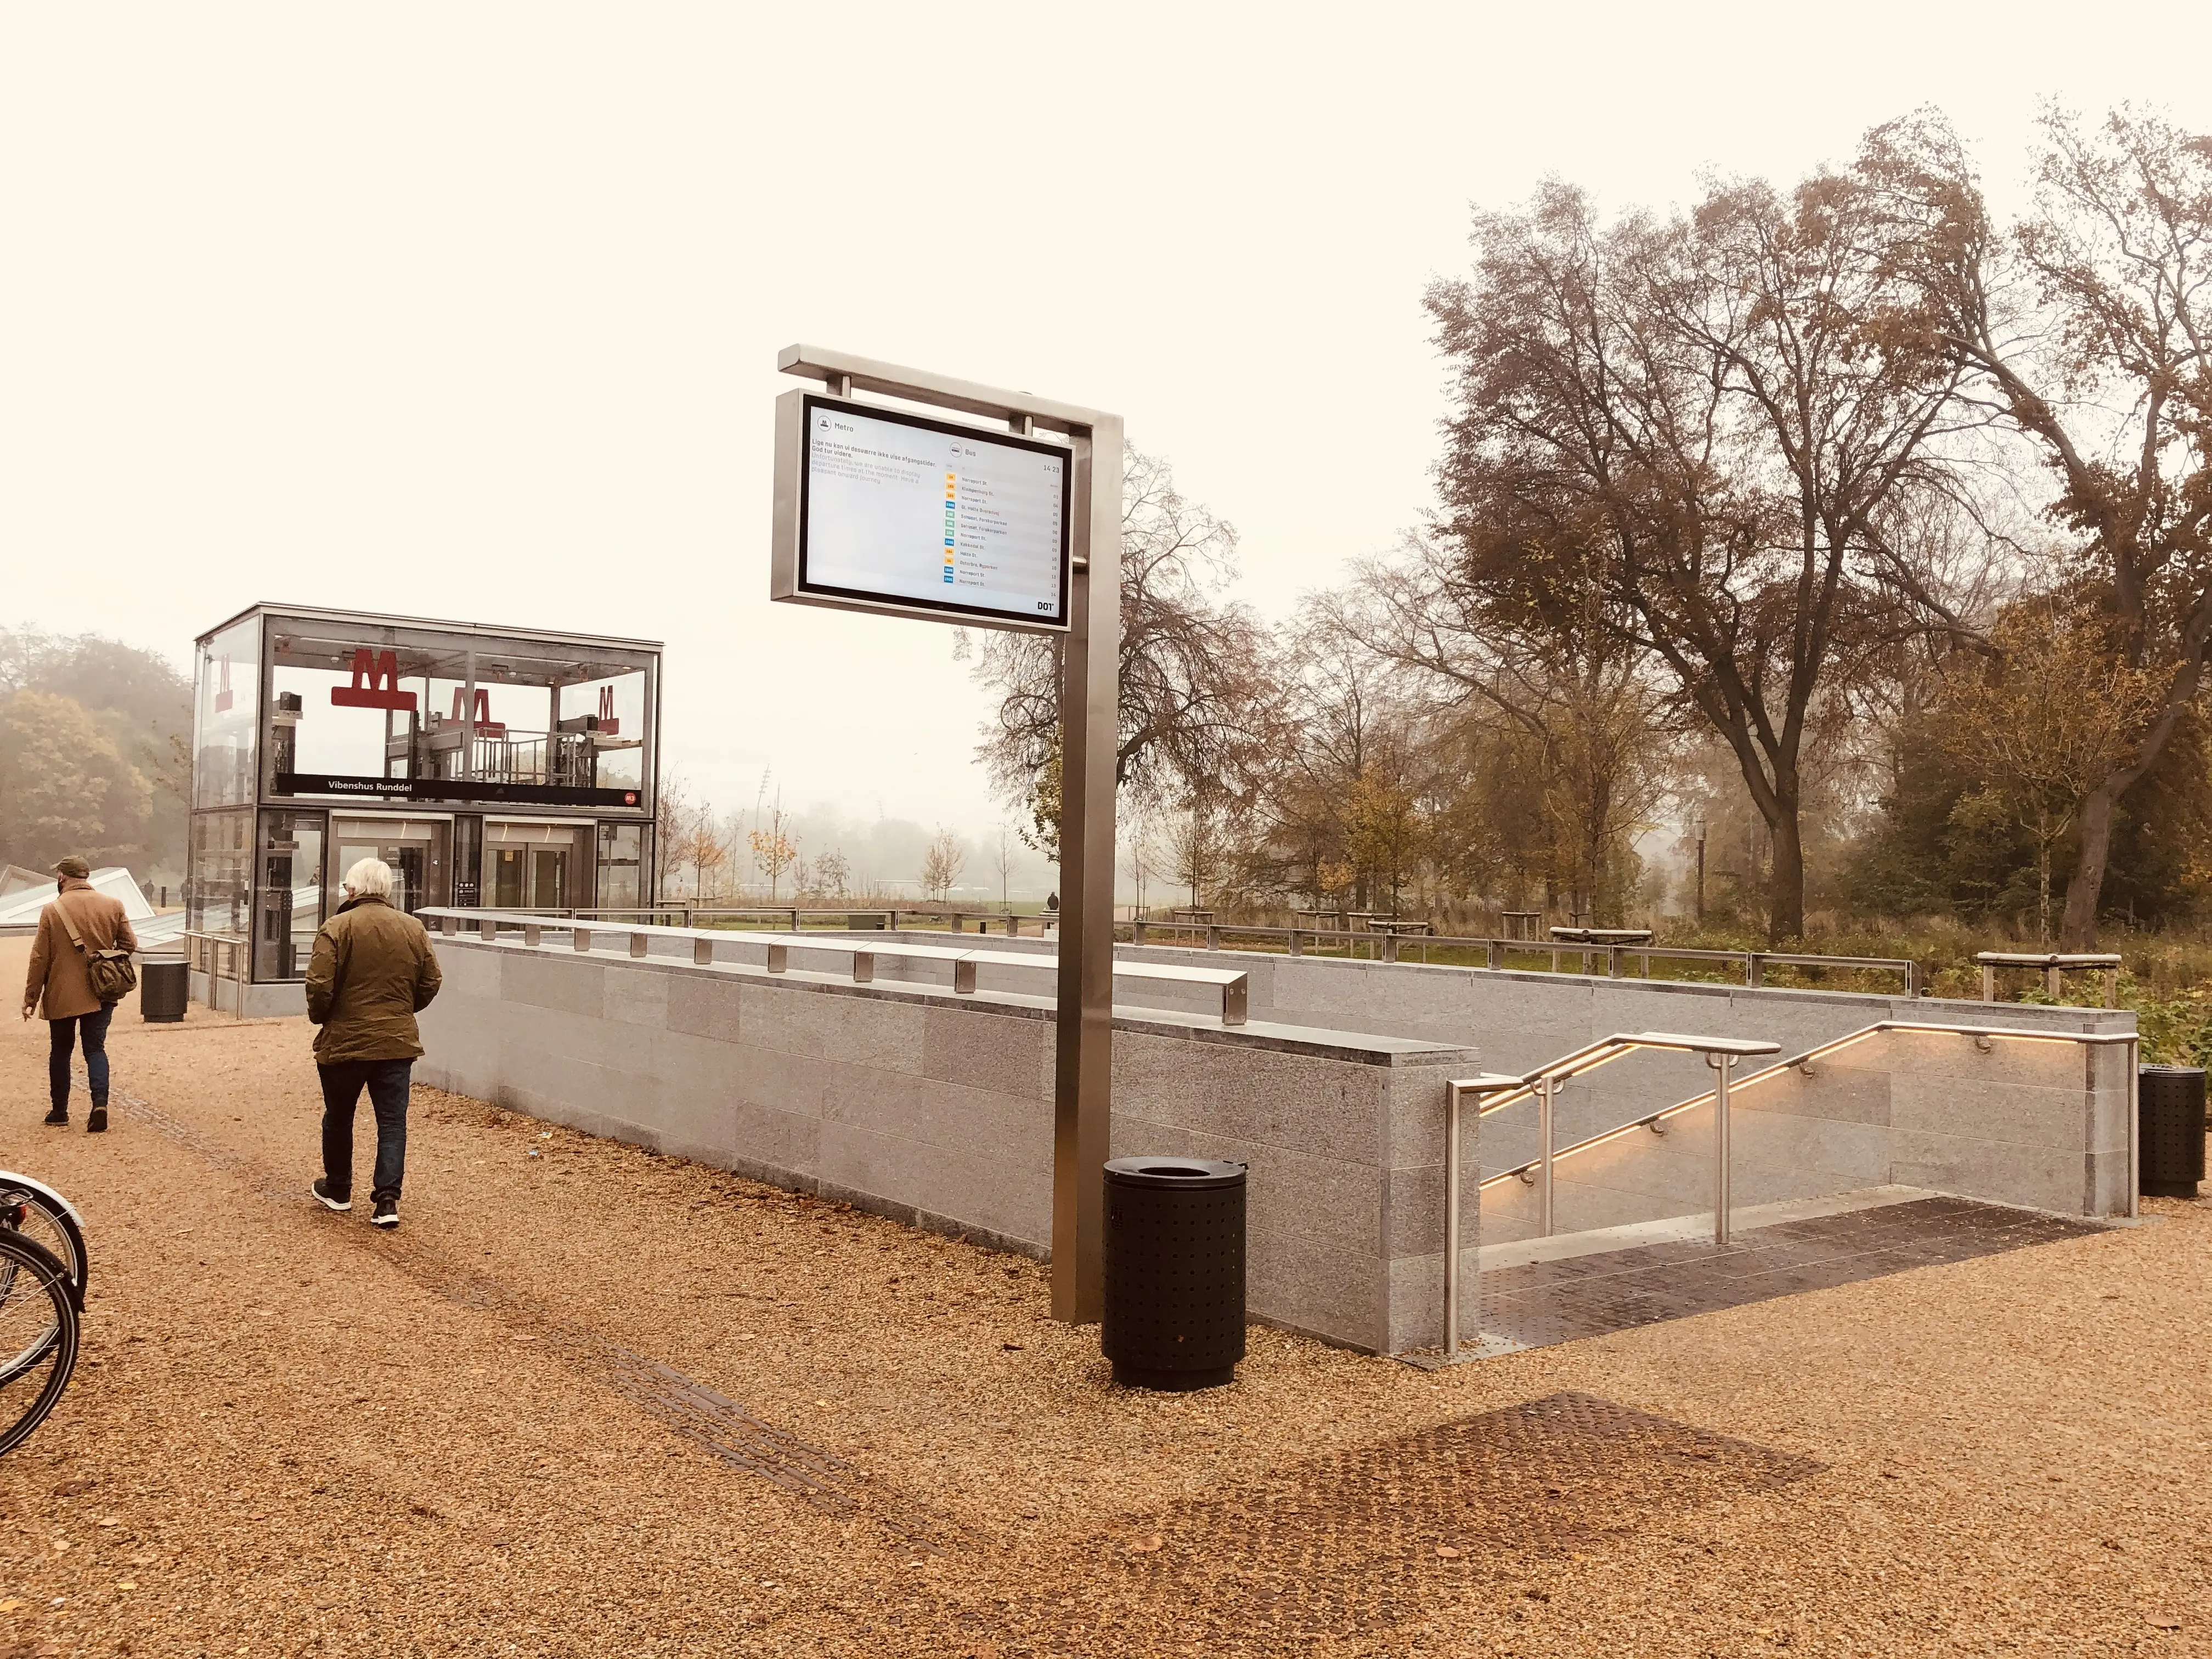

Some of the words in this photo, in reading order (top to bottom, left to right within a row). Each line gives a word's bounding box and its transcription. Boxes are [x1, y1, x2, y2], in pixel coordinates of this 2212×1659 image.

[834, 422, 854, 432] Metro
[834, 450, 853, 458] videre.
[851, 446, 876, 456] desværre
[902, 456, 936, 467] afgangstider.
[965, 449, 976, 457] Bus
[812, 460, 840, 469] departure
[811, 467, 837, 476] pleasant
[901, 470, 921, 479] display
[1037, 601, 1053, 611] DOT
[328, 781, 374, 790] Vibenshus
[376, 783, 412, 792] Runddel
